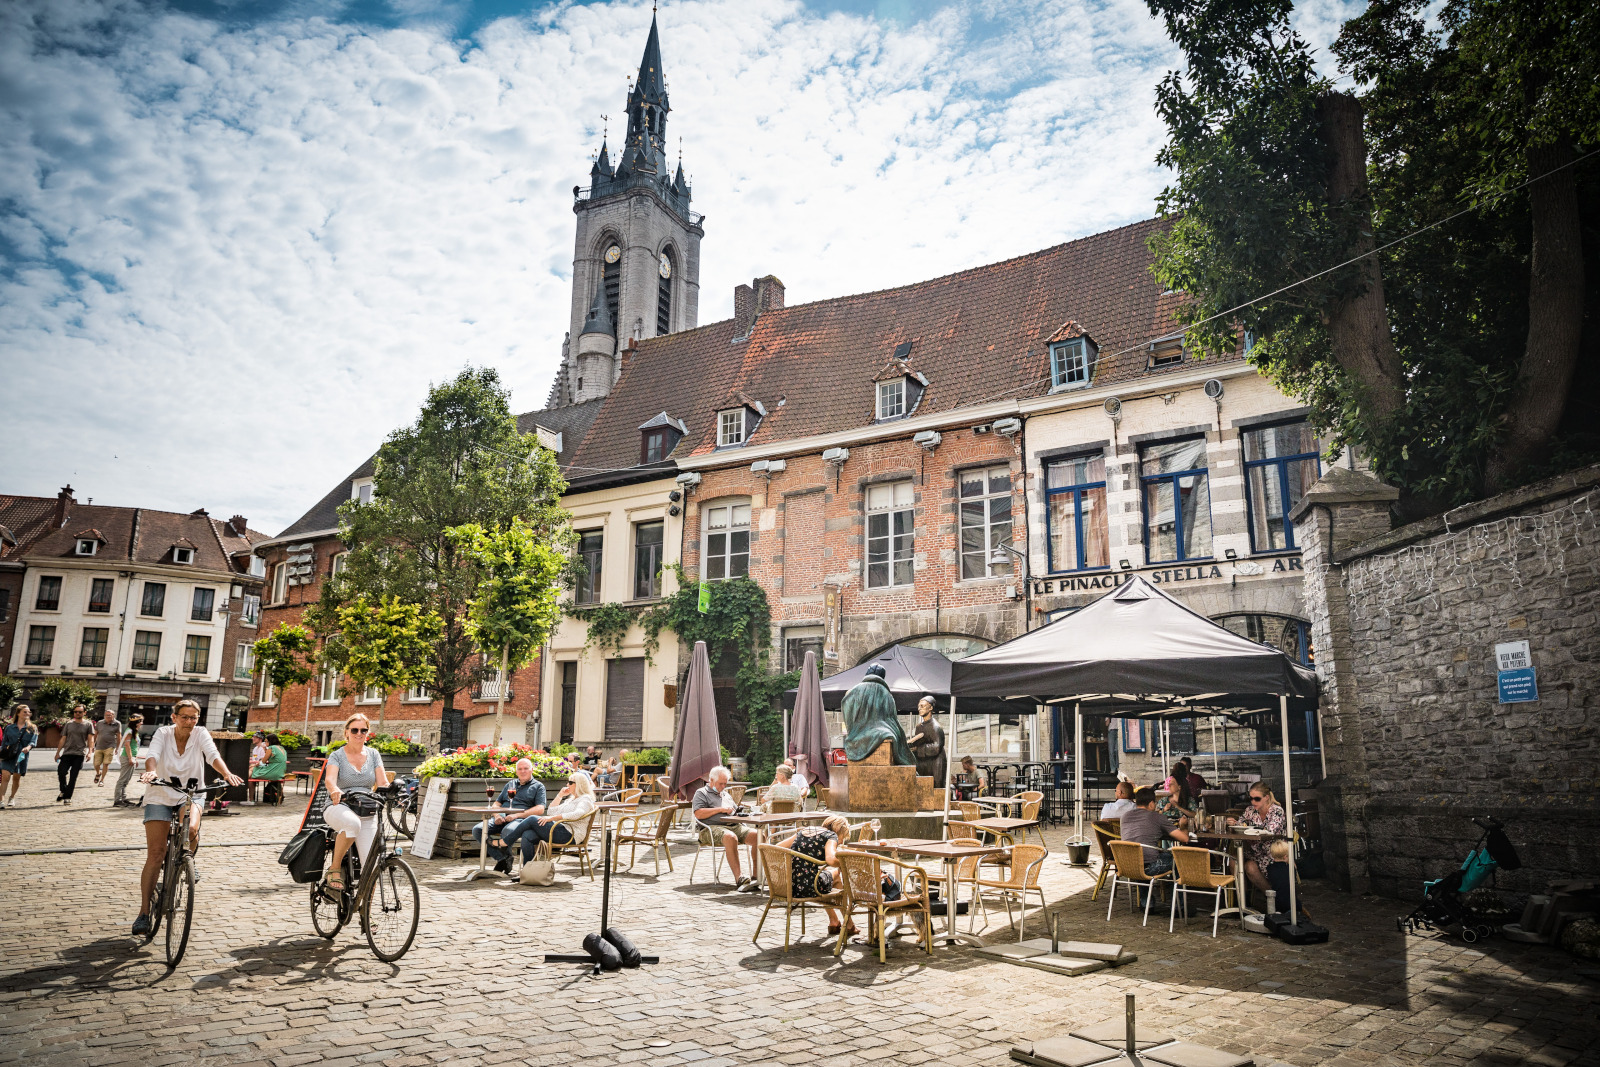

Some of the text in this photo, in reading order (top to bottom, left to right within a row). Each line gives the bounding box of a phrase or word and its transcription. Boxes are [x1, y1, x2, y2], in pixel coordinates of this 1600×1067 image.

[1034, 580, 1054, 595] LE
[1152, 565, 1223, 584] STELLA
[1271, 557, 1304, 573] AR
